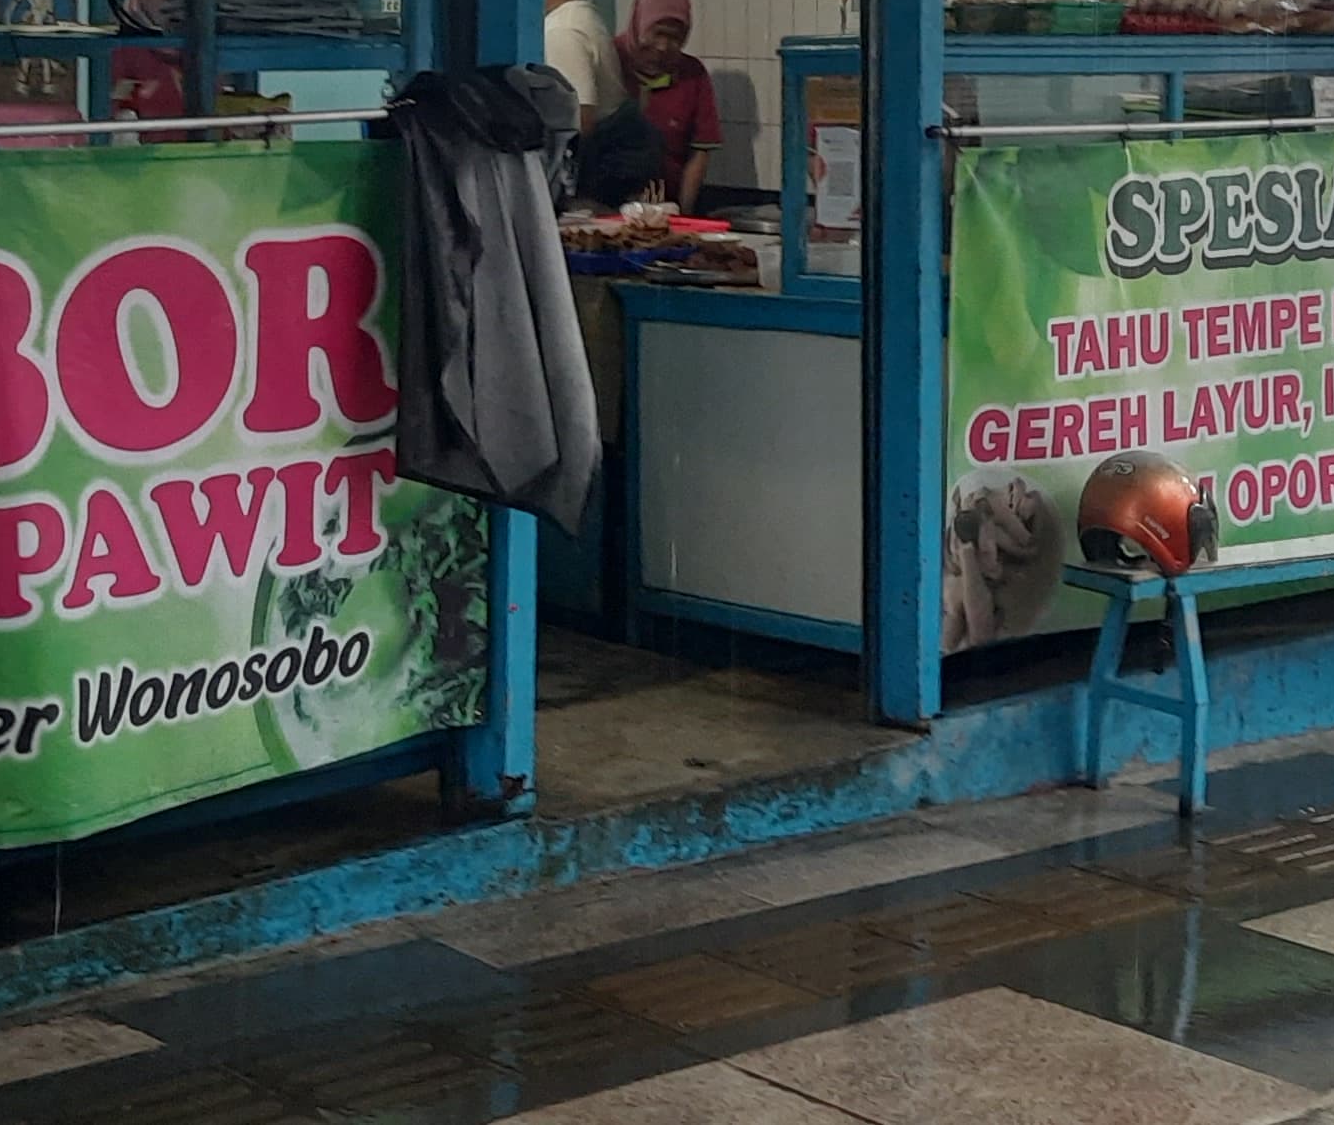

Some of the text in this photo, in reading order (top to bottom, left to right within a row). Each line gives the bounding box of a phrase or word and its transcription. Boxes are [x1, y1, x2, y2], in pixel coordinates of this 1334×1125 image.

[1051, 312, 1168, 375] TAHU
[1182, 294, 1322, 360] TEMPE
[969, 398, 1147, 462] GEREH
[1163, 374, 1311, 442] LAYUR,
[78, 626, 370, 743] Wonosobo
